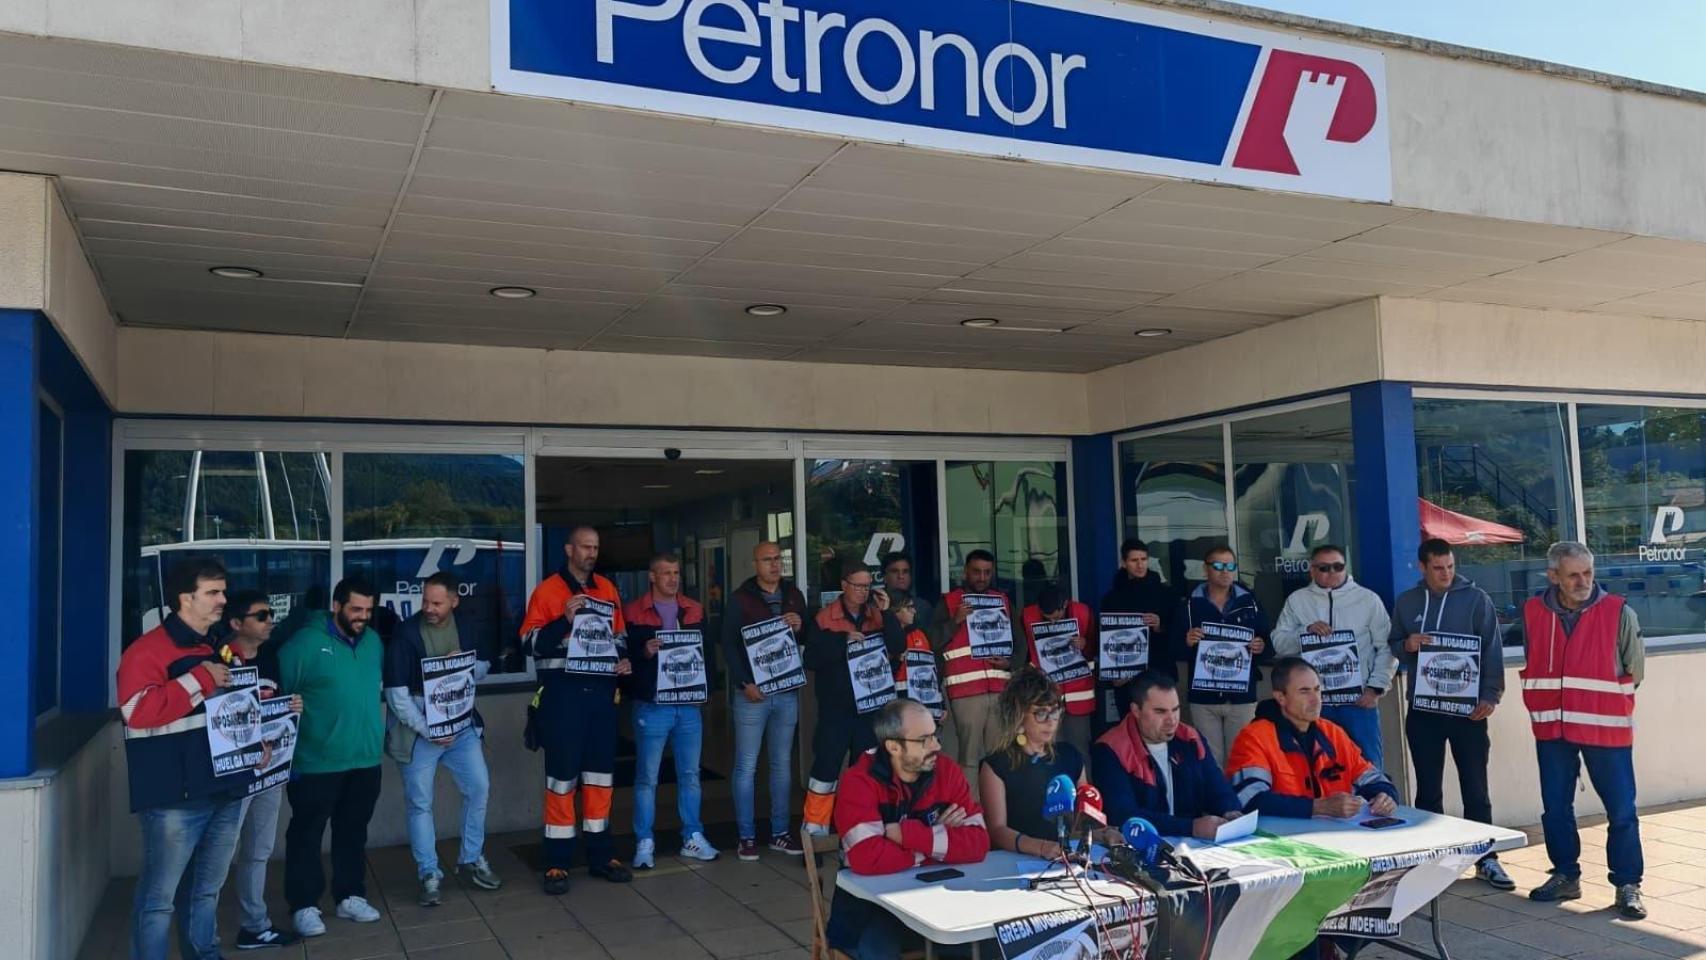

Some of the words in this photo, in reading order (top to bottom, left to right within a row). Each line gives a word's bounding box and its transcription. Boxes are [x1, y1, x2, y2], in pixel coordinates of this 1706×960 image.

[596, 0, 1086, 130] Petronor
[1639, 545, 1687, 561] Petronor
[1275, 556, 1310, 573] Petro
[1415, 697, 1439, 710] HUELGA
[215, 753, 244, 774] HUELGA
[1371, 857, 1395, 872] GREBA
[998, 922, 1034, 944] GREBA
[1350, 916, 1399, 934] INDEFINIDA
